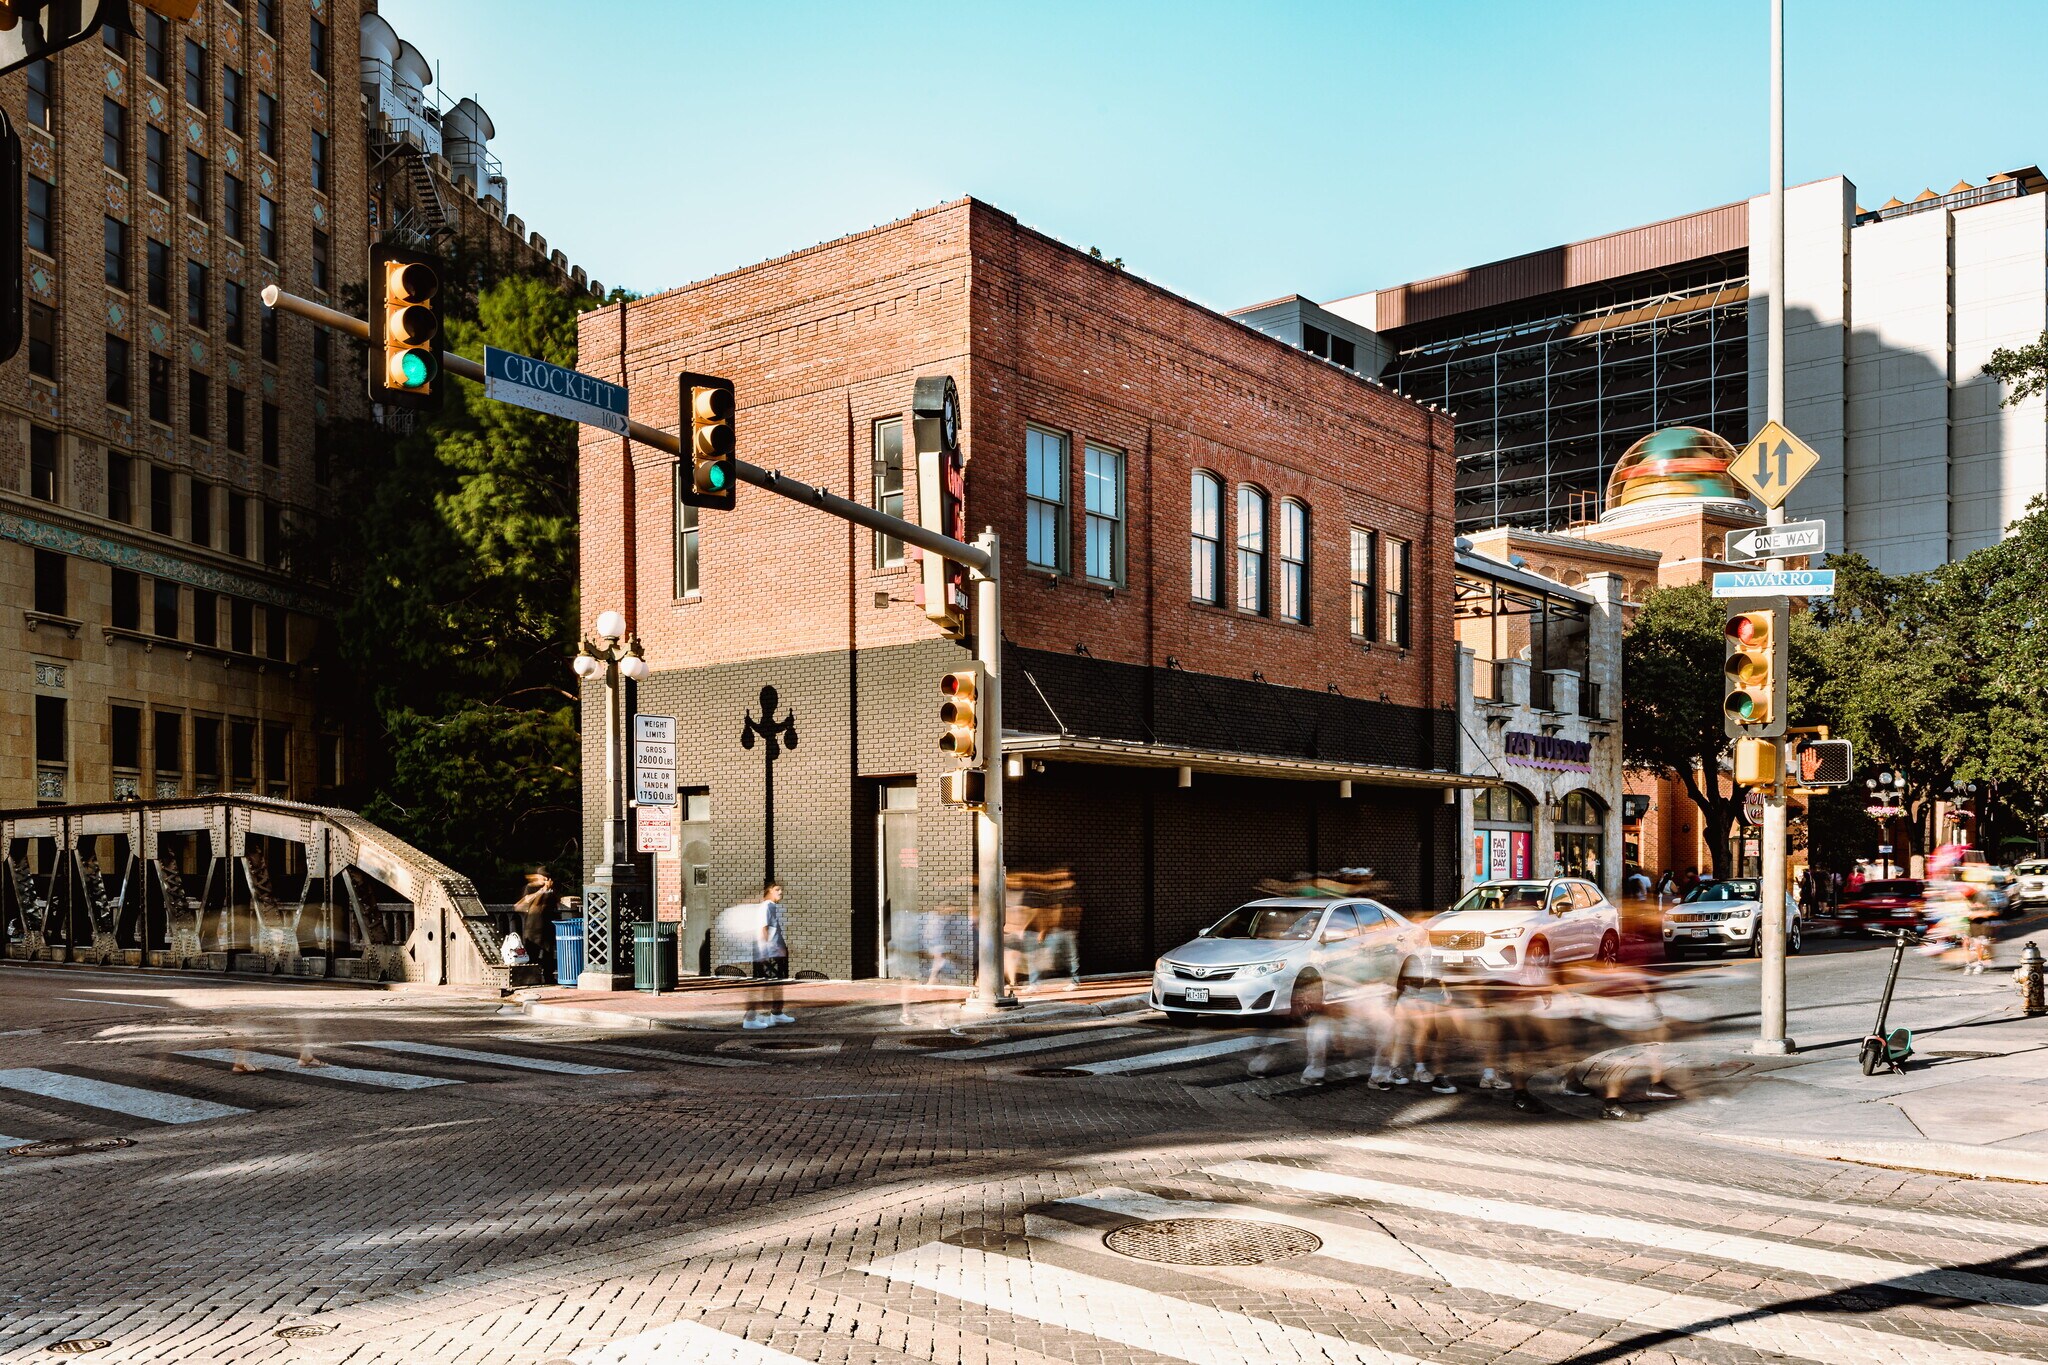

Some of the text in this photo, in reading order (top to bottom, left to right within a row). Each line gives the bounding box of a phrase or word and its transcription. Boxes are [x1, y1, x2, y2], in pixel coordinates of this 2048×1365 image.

[504, 355, 615, 410] CROCKETT
[602, 411, 617, 430] 100
[1755, 531, 1815, 549] ONE WAY
[1733, 572, 1814, 587] NAVARRO
[644, 720, 667, 728] WEIGHT
[645, 730, 666, 739] LIMITS
[645, 746, 667, 754] GROSS
[1505, 732, 1593, 763] FAT TUESDAY
[639, 755, 664, 765] 28000
[644, 781, 668, 789] TANDEM
[639, 791, 674, 801] 17500 LBS
[1493, 838, 1506, 849] FAT
[1493, 849, 1506, 858] TUES
[1493, 858, 1506, 867] DAY
